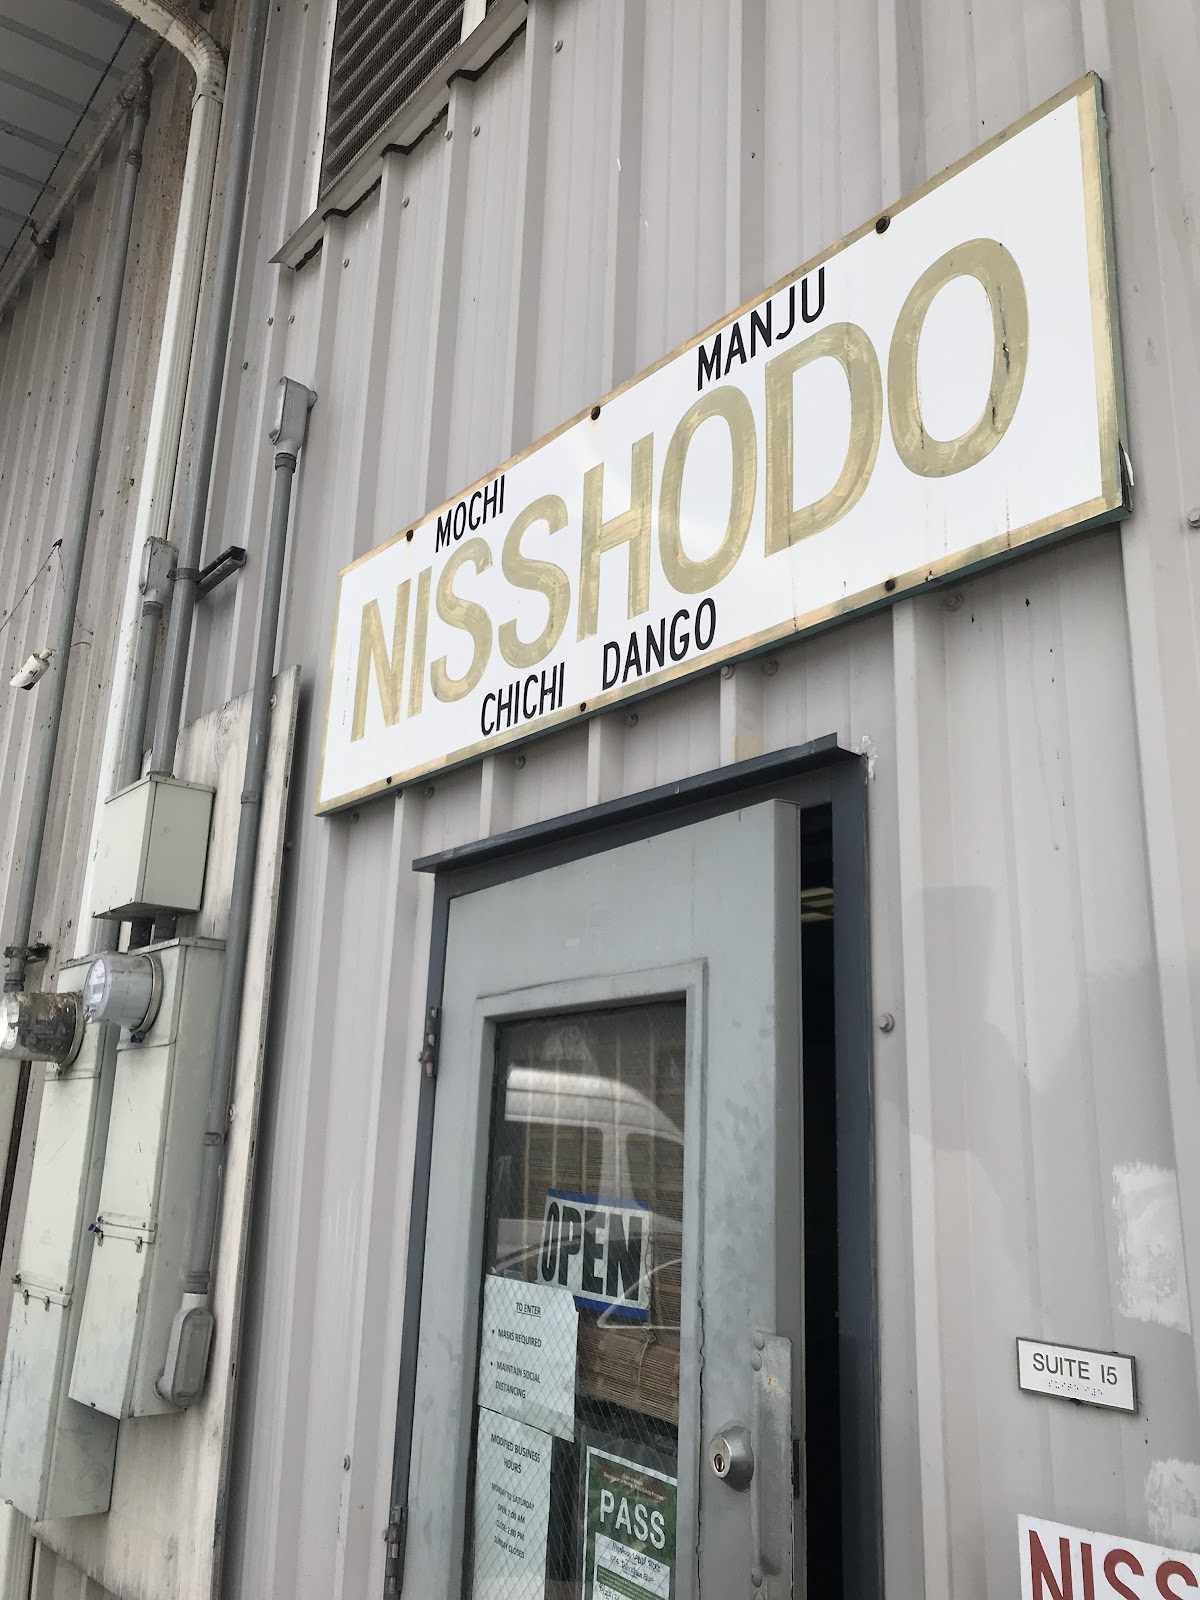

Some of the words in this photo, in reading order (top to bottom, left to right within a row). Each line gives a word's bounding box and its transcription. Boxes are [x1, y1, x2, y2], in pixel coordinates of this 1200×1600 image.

[697, 266, 826, 392] MANJU
[350, 237, 1029, 743] NISSHODO
[435, 474, 505, 553] MOCHI
[480, 661, 565, 737] CHICHI
[602, 597, 716, 691] DANGO
[541, 1201, 643, 1301] OPEN
[516, 1302, 523, 1312] TO
[524, 1304, 541, 1316] ENTER
[498, 1329, 514, 1341] MASKS
[515, 1333, 542, 1348] REQUIRED
[496, 1361, 522, 1377] MAINTAIN
[523, 1369, 541, 1384] SOCIAL
[1032, 1352, 1091, 1381] SUITE
[1100, 1364, 1118, 1386] 15
[495, 1380, 526, 1399] DISTANCING
[491, 1433, 514, 1452] MODIFIED
[515, 1444, 540, 1463] BUSINESS
[504, 1457, 521, 1474] HOURS
[600, 1488, 666, 1549] PASS
